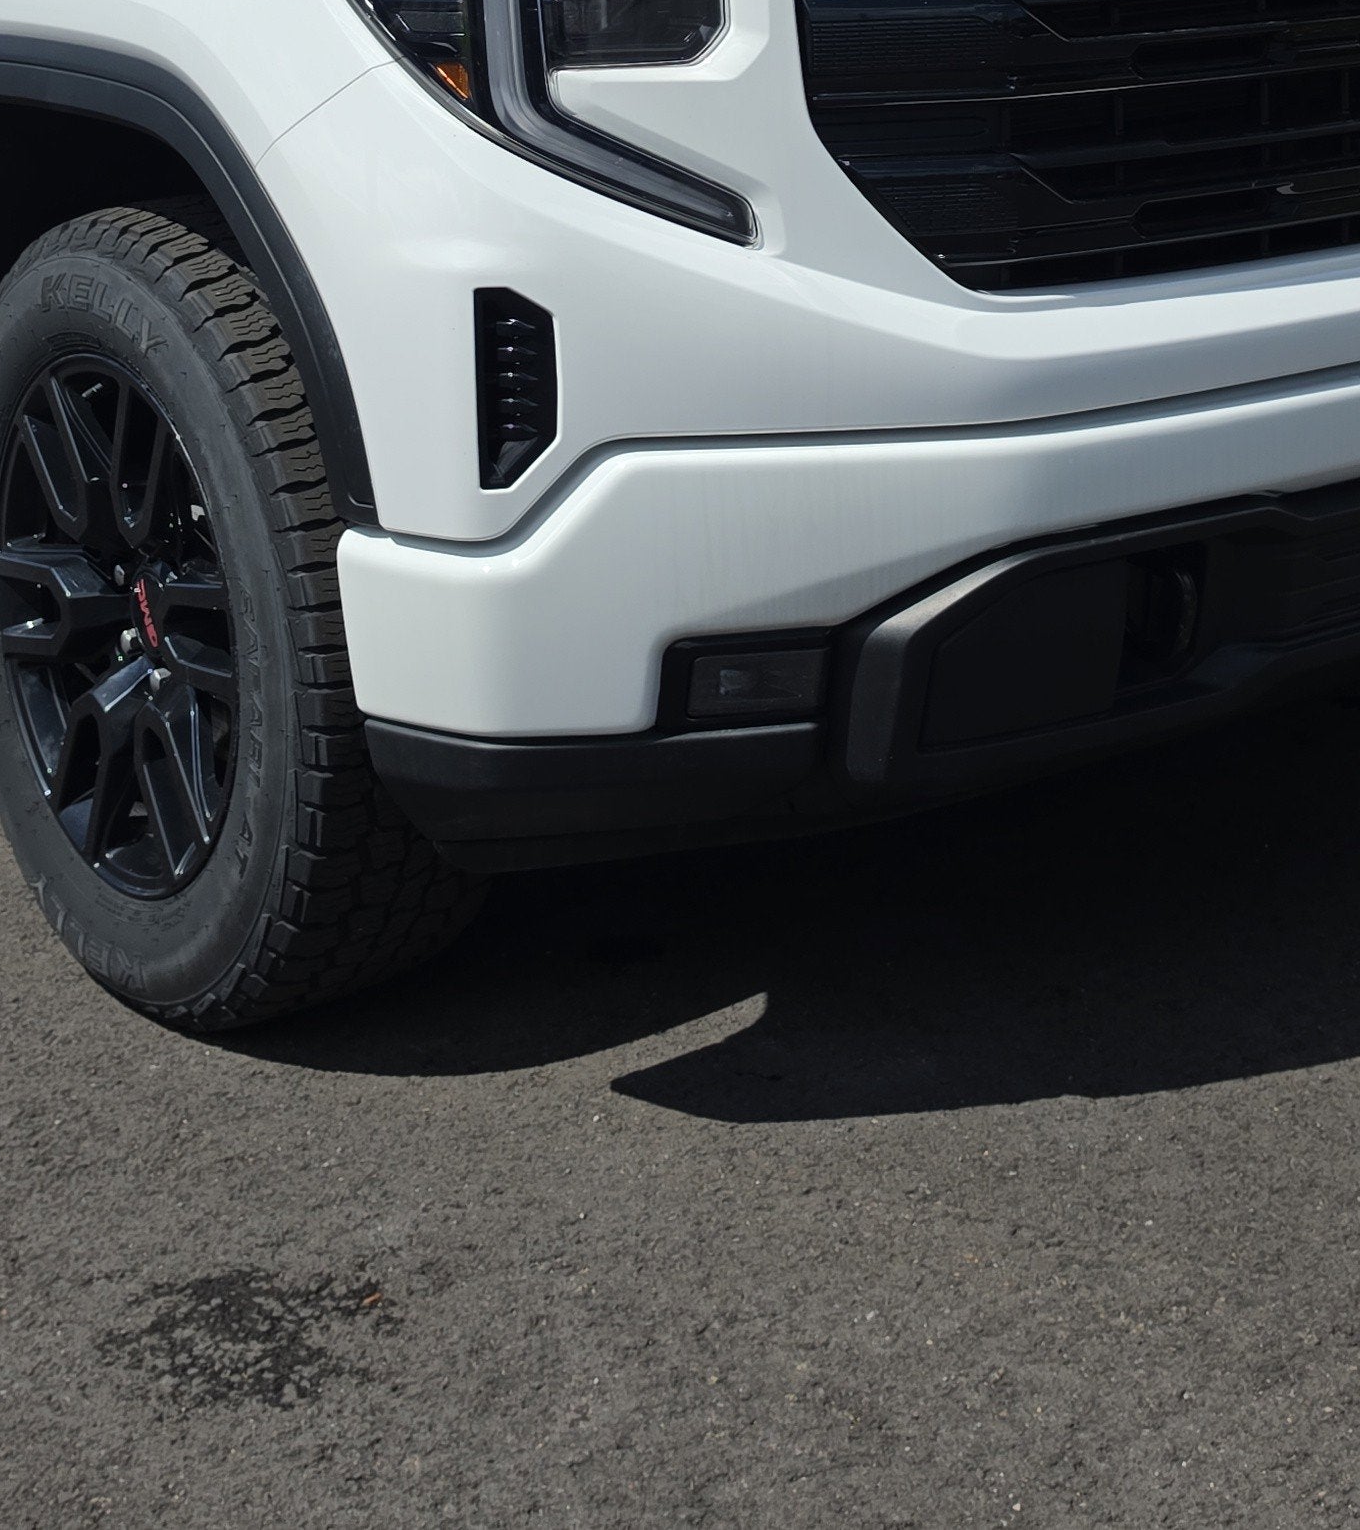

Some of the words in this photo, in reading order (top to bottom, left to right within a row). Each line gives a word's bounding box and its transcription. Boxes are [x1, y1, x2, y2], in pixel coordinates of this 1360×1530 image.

[40, 272, 168, 358] KELLY
[134, 578, 159, 648] GMC
[26, 872, 148, 991] KELLY
